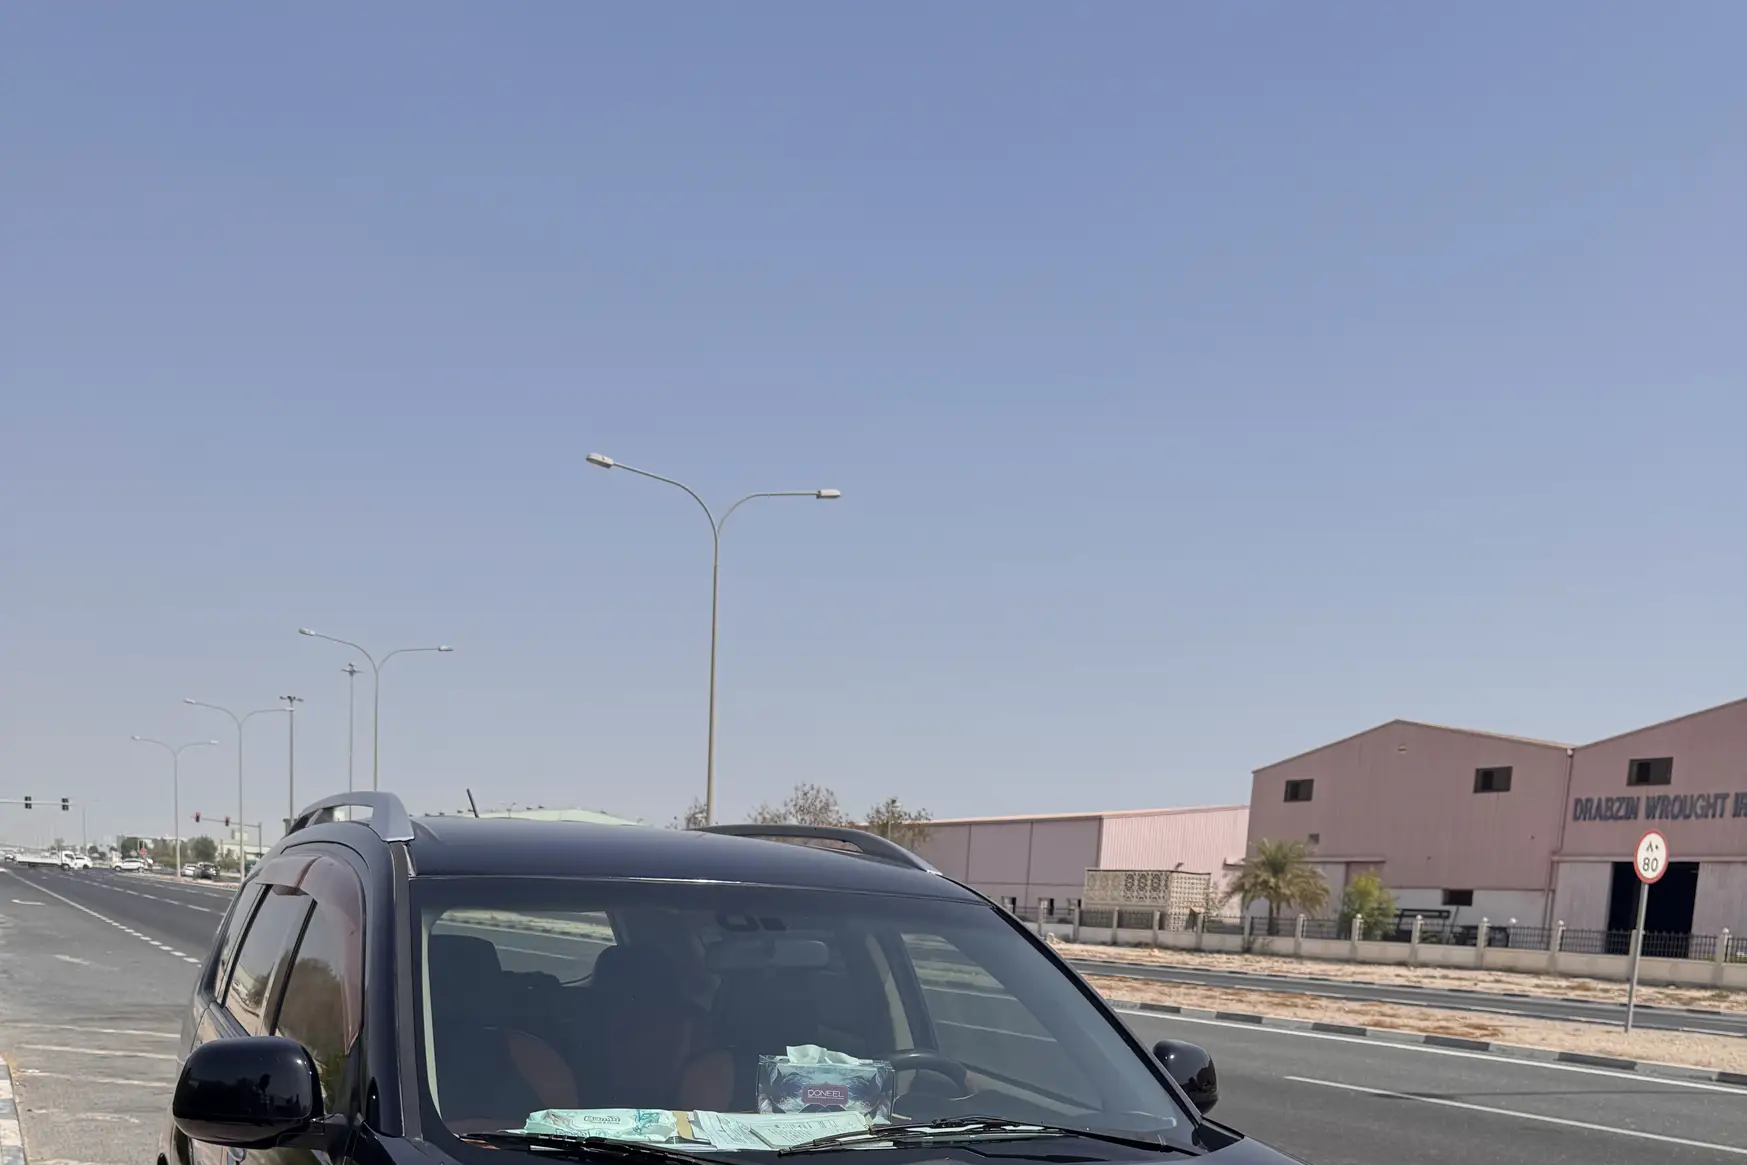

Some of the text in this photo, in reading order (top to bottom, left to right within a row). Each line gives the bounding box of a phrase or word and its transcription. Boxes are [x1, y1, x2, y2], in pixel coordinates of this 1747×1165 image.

[1573, 795, 1639, 822] DRABZIN
[1644, 792, 1730, 820] WROUGHT
[1642, 857, 1659, 873] 80
